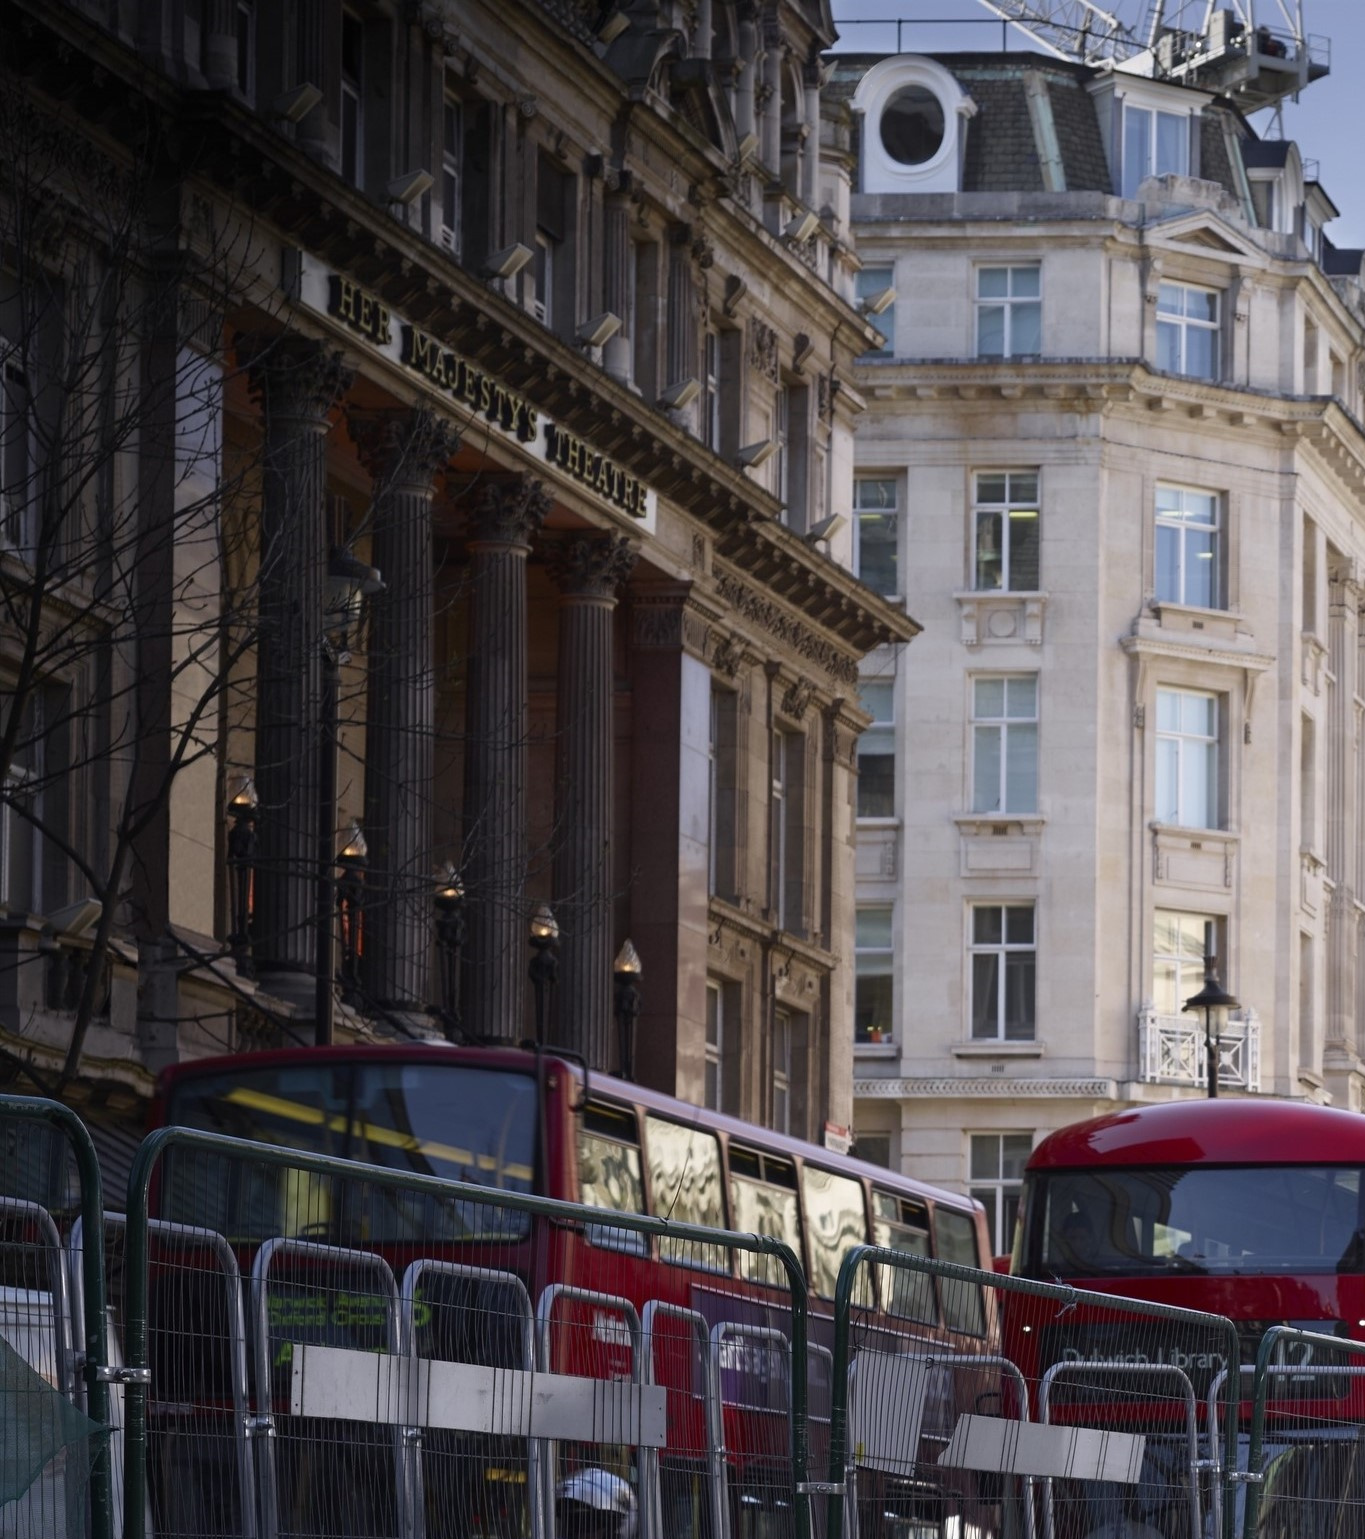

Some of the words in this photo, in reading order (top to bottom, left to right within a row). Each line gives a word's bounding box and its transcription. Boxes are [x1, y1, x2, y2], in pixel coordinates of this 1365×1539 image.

[333, 277, 392, 345] HER
[406, 326, 537, 442] MAJESTY'S
[549, 426, 647, 517] THEATRE
[1157, 1347, 1229, 1370] Library
